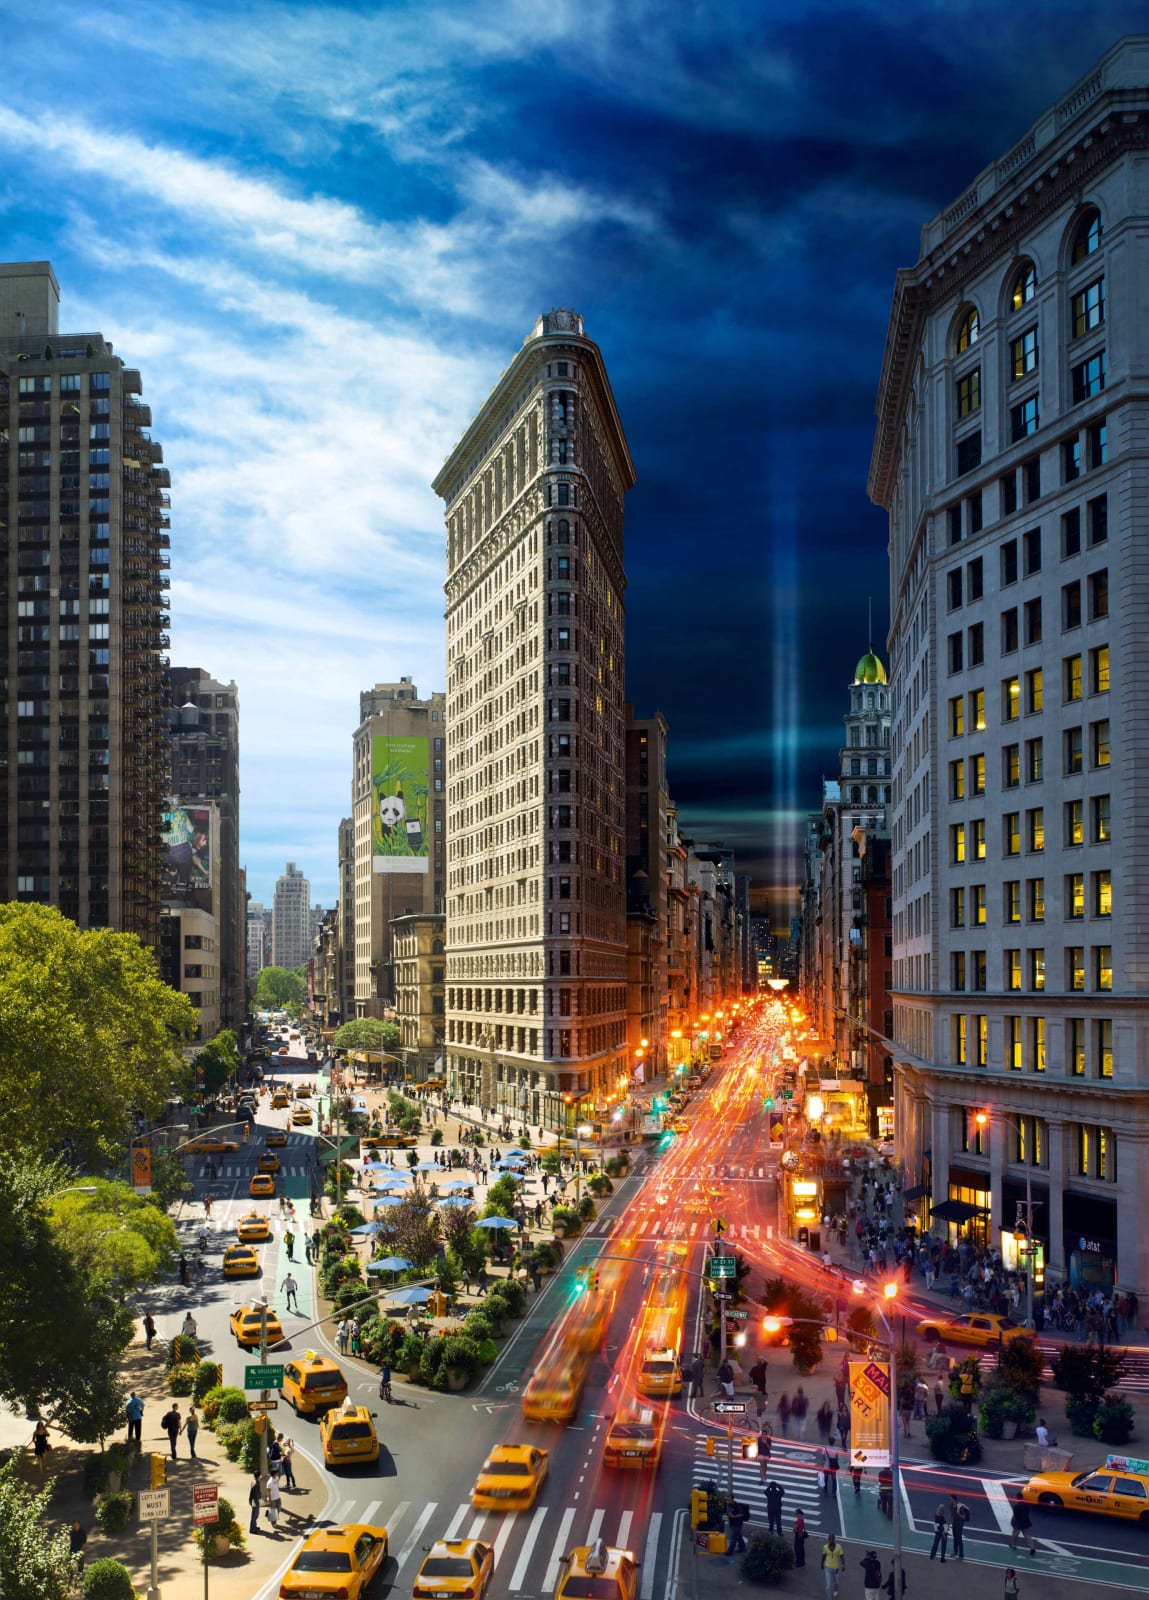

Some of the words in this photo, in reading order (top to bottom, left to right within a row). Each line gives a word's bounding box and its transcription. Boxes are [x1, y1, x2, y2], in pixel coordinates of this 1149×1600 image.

[1086, 1241, 1100, 1253] at&t
[154, 1492, 166, 1500] LANE
[146, 1501, 162, 1509] MUST
